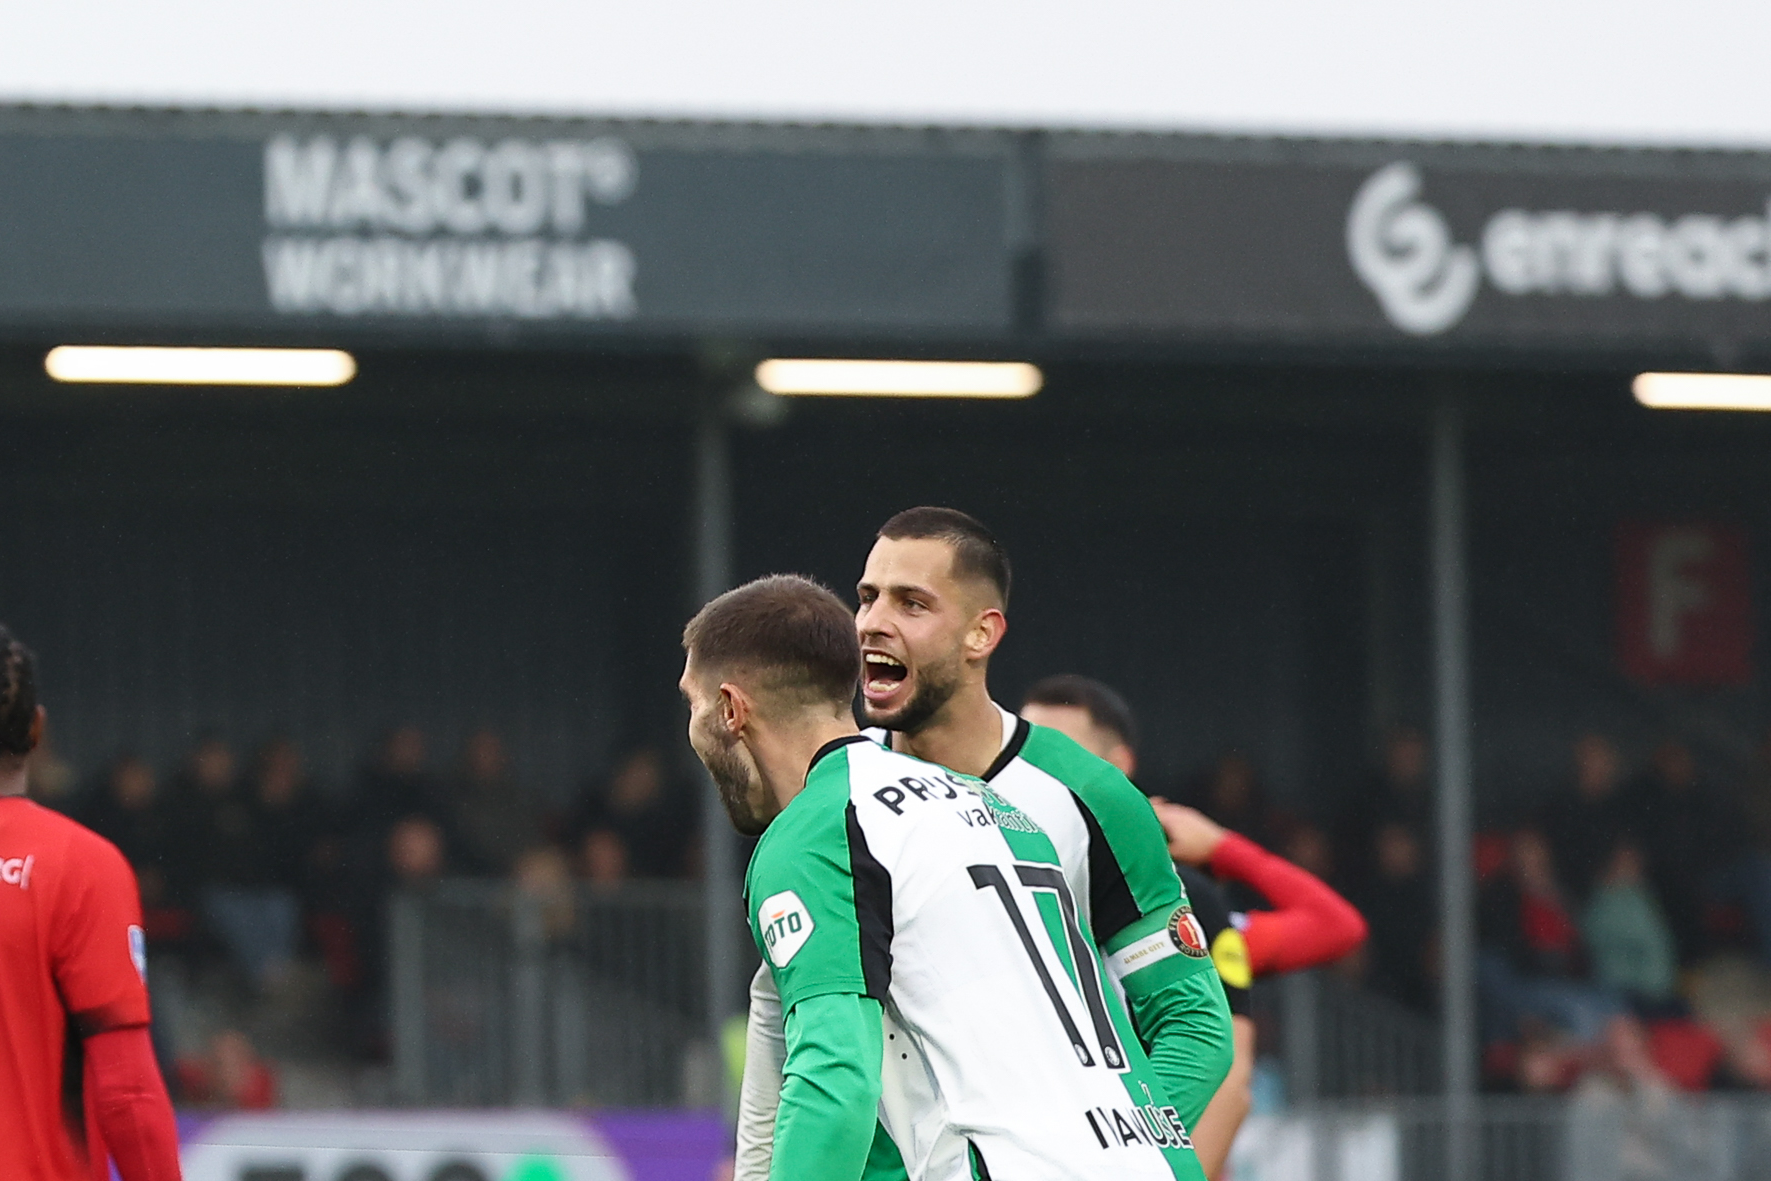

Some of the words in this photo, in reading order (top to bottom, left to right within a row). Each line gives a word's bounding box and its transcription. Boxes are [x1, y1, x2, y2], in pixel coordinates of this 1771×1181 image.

[1481, 196, 1771, 300] enreac
[1649, 530, 1714, 657] F
[764, 911, 803, 955] OTO
[966, 864, 1128, 1070] 17
